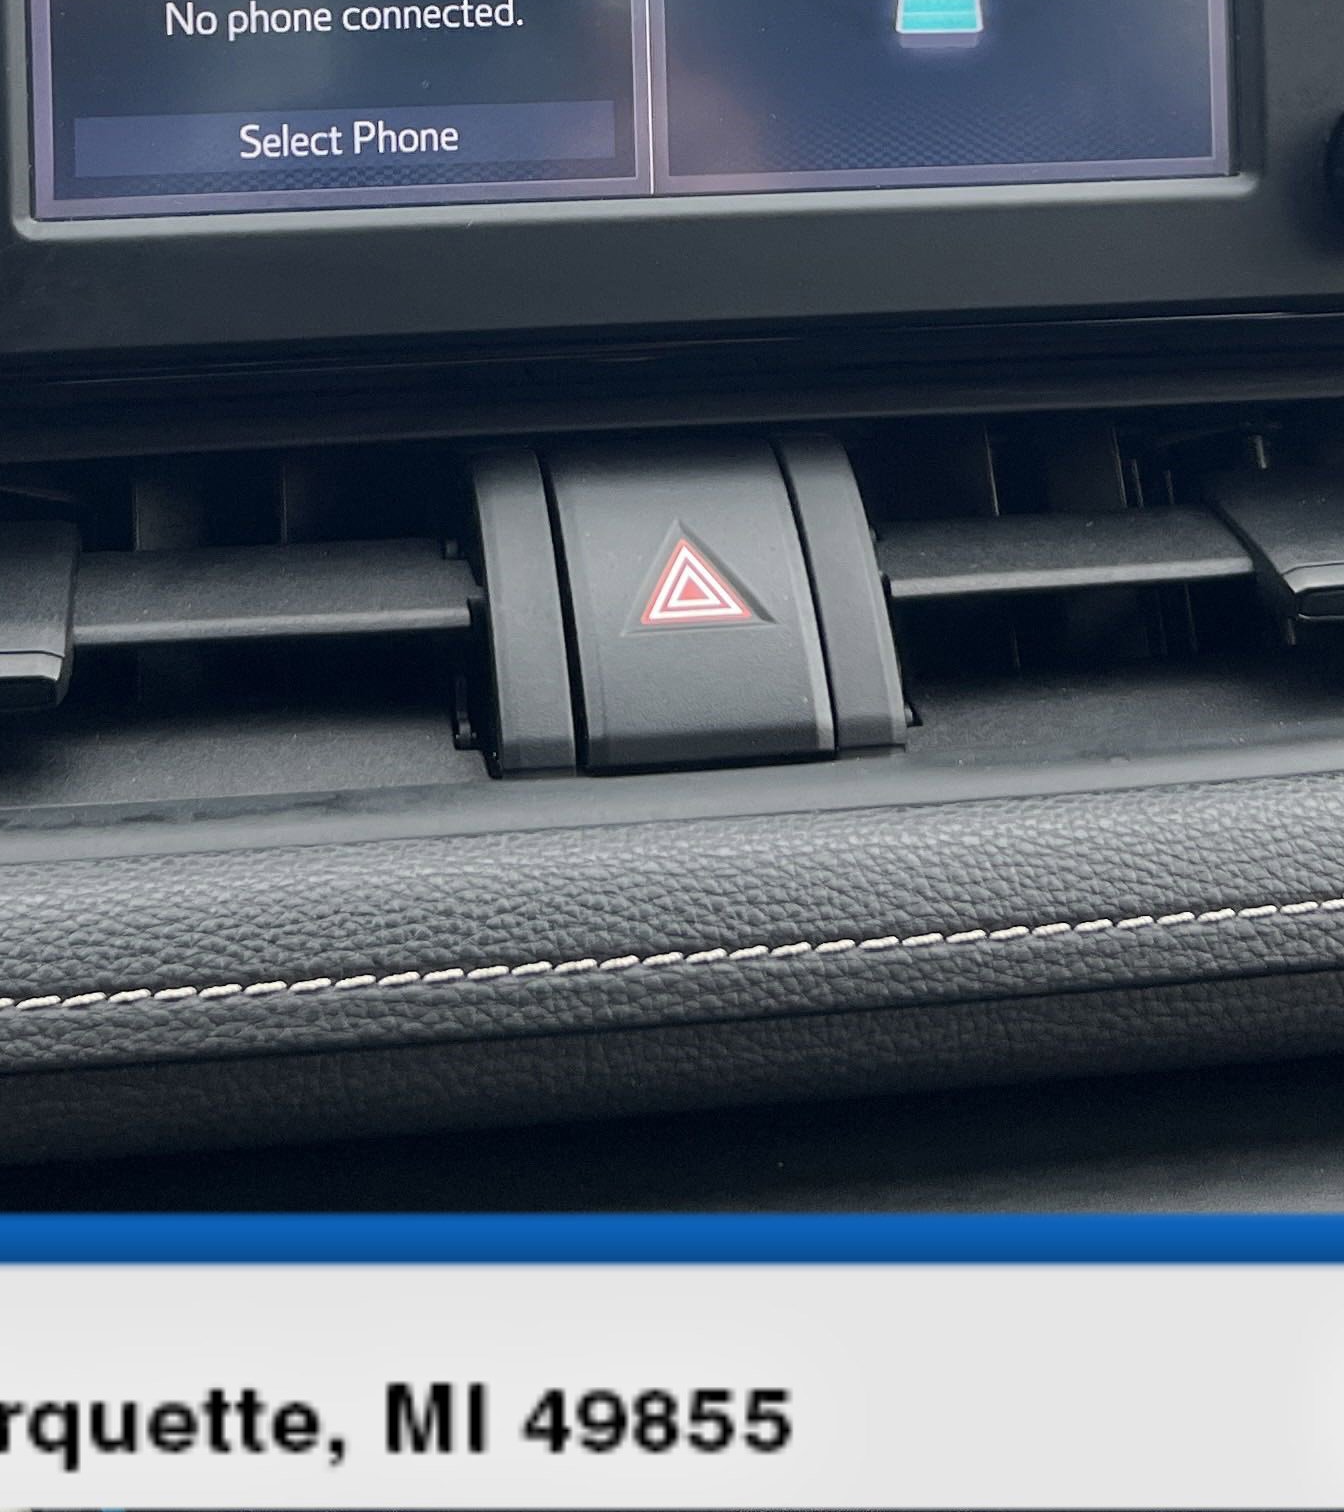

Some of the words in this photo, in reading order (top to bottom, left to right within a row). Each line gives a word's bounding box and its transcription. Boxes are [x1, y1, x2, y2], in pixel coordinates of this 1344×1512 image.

[165, 3, 218, 36] No
[228, 1, 333, 41] phone
[239, 124, 342, 159] Select
[353, 120, 459, 154] Phone
